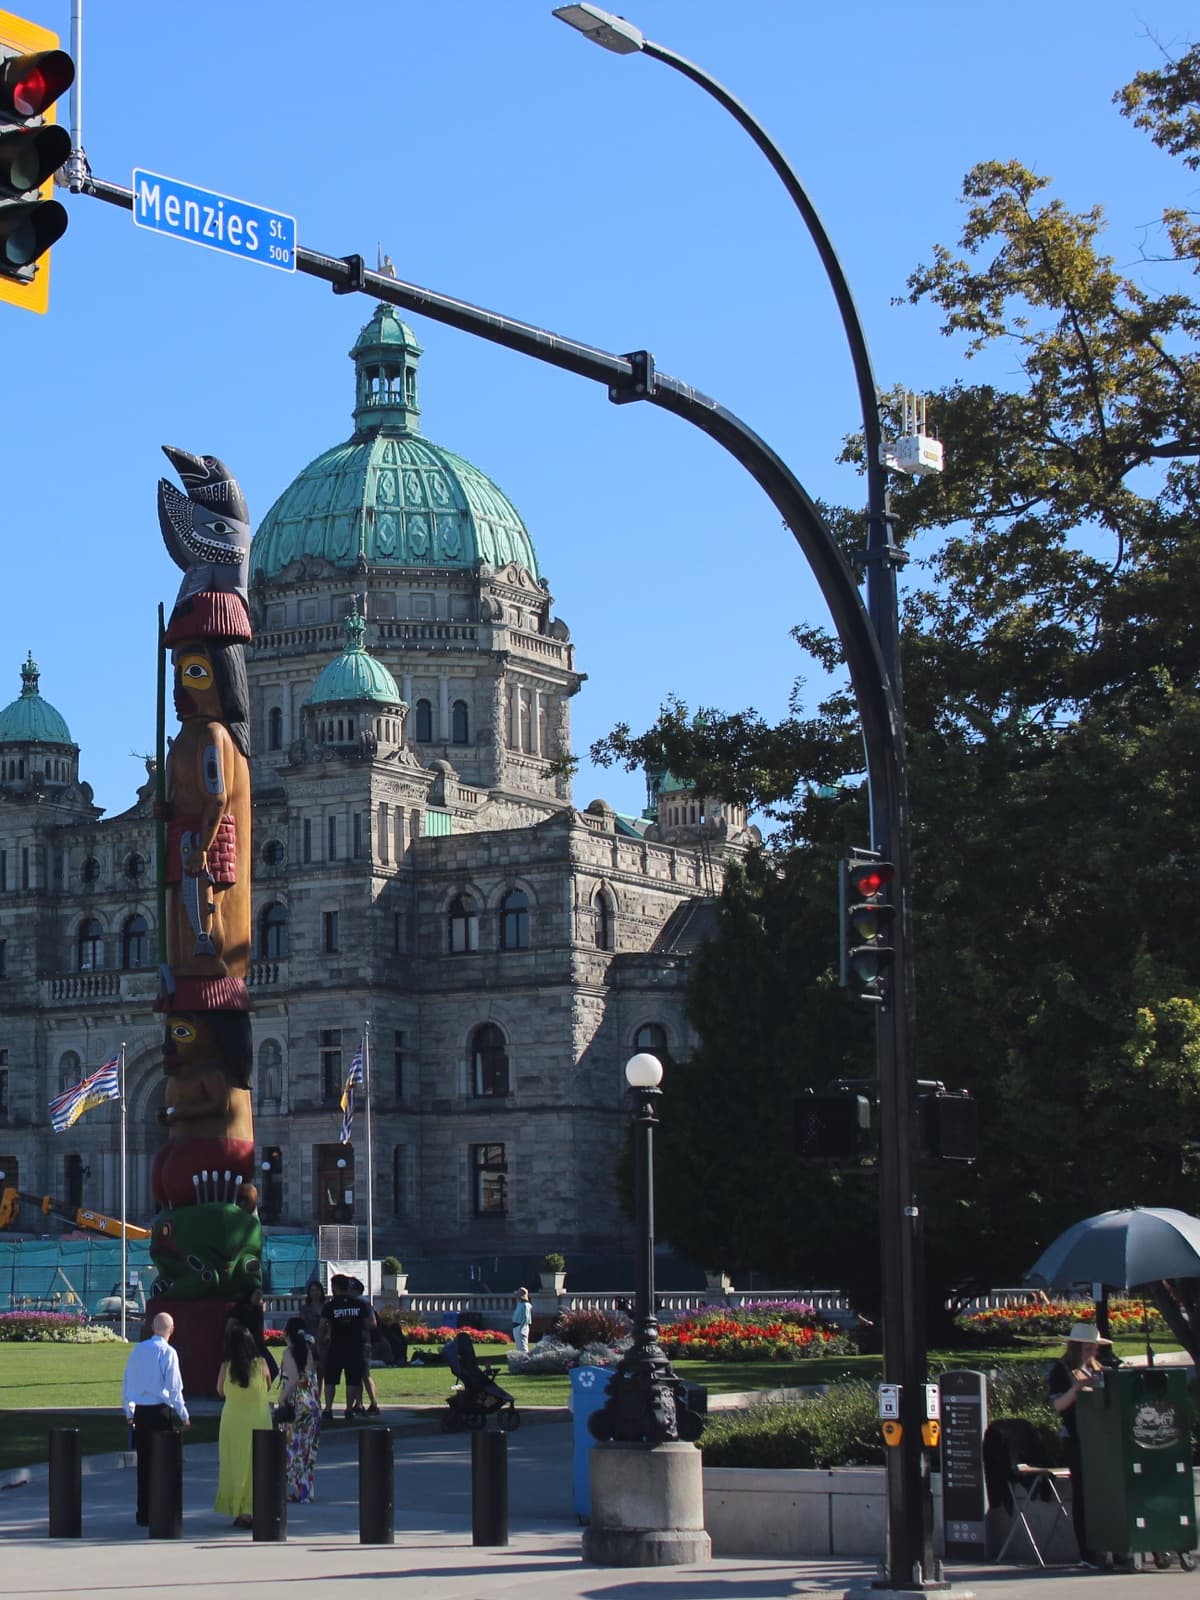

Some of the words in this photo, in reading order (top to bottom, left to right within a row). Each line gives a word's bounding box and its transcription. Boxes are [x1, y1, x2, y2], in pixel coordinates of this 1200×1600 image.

[140, 180, 258, 251] Menzies
[269, 219, 287, 241] St.
[269, 245, 289, 263] 500
